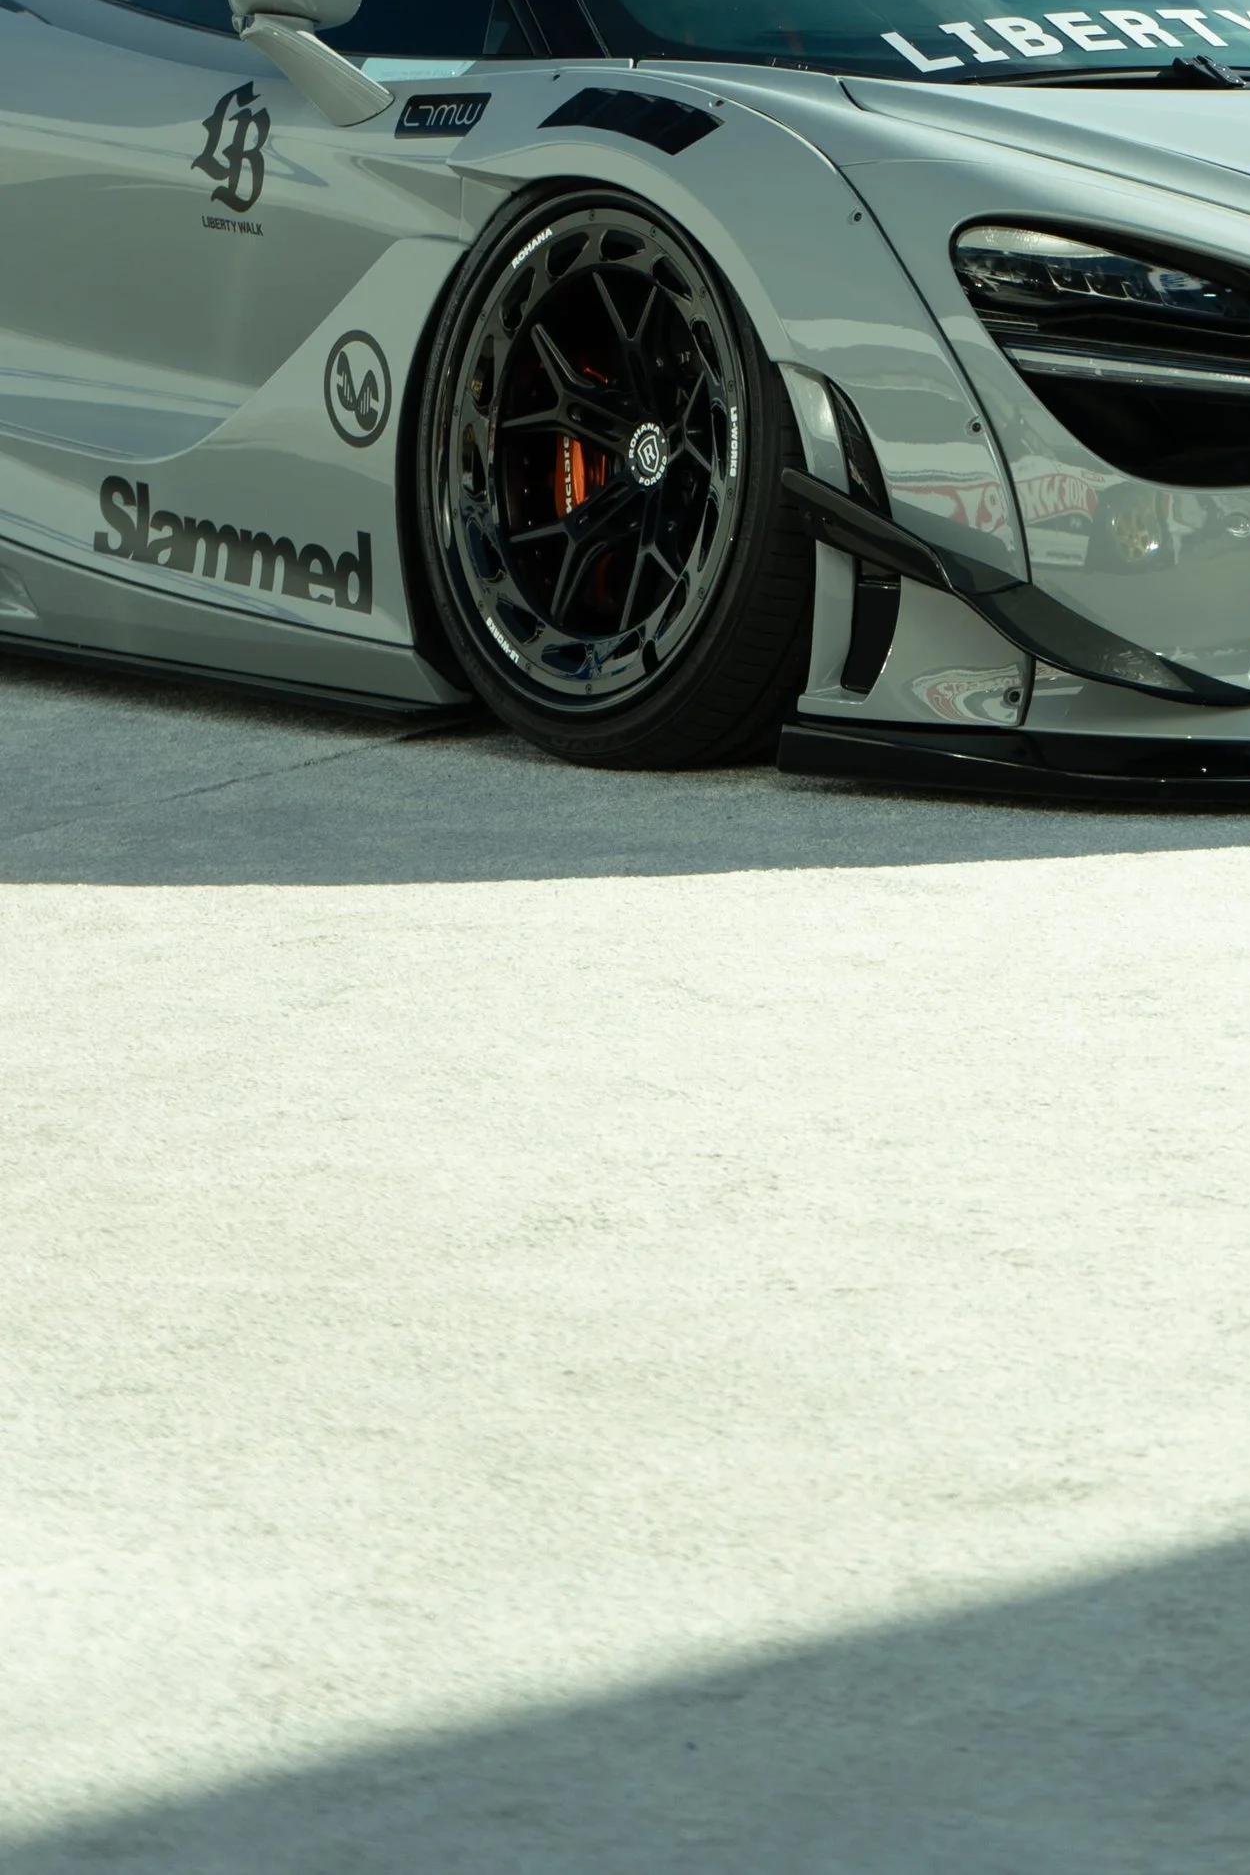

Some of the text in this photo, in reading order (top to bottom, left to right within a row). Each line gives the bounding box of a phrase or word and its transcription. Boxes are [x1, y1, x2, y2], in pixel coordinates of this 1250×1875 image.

[202, 215, 264, 236] LIBERTY WALK
[511, 228, 553, 269] ROHANA
[628, 423, 660, 459] ROHANA
[94, 475, 372, 615] Slammed
